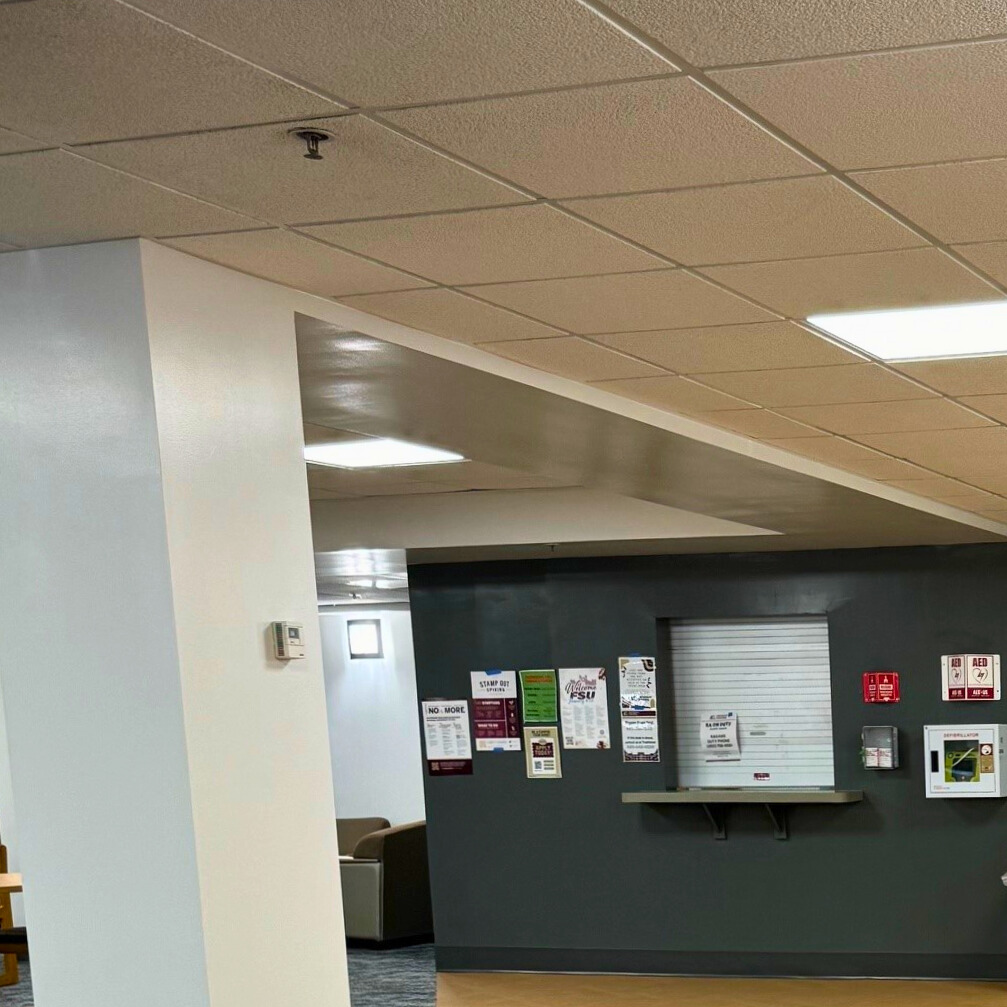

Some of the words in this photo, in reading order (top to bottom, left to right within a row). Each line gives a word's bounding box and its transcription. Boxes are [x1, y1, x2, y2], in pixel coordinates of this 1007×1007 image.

[951, 658, 961, 667] AED
[972, 658, 988, 667] AED
[565, 680, 597, 694] Welcome
[570, 691, 596, 700] FSU
